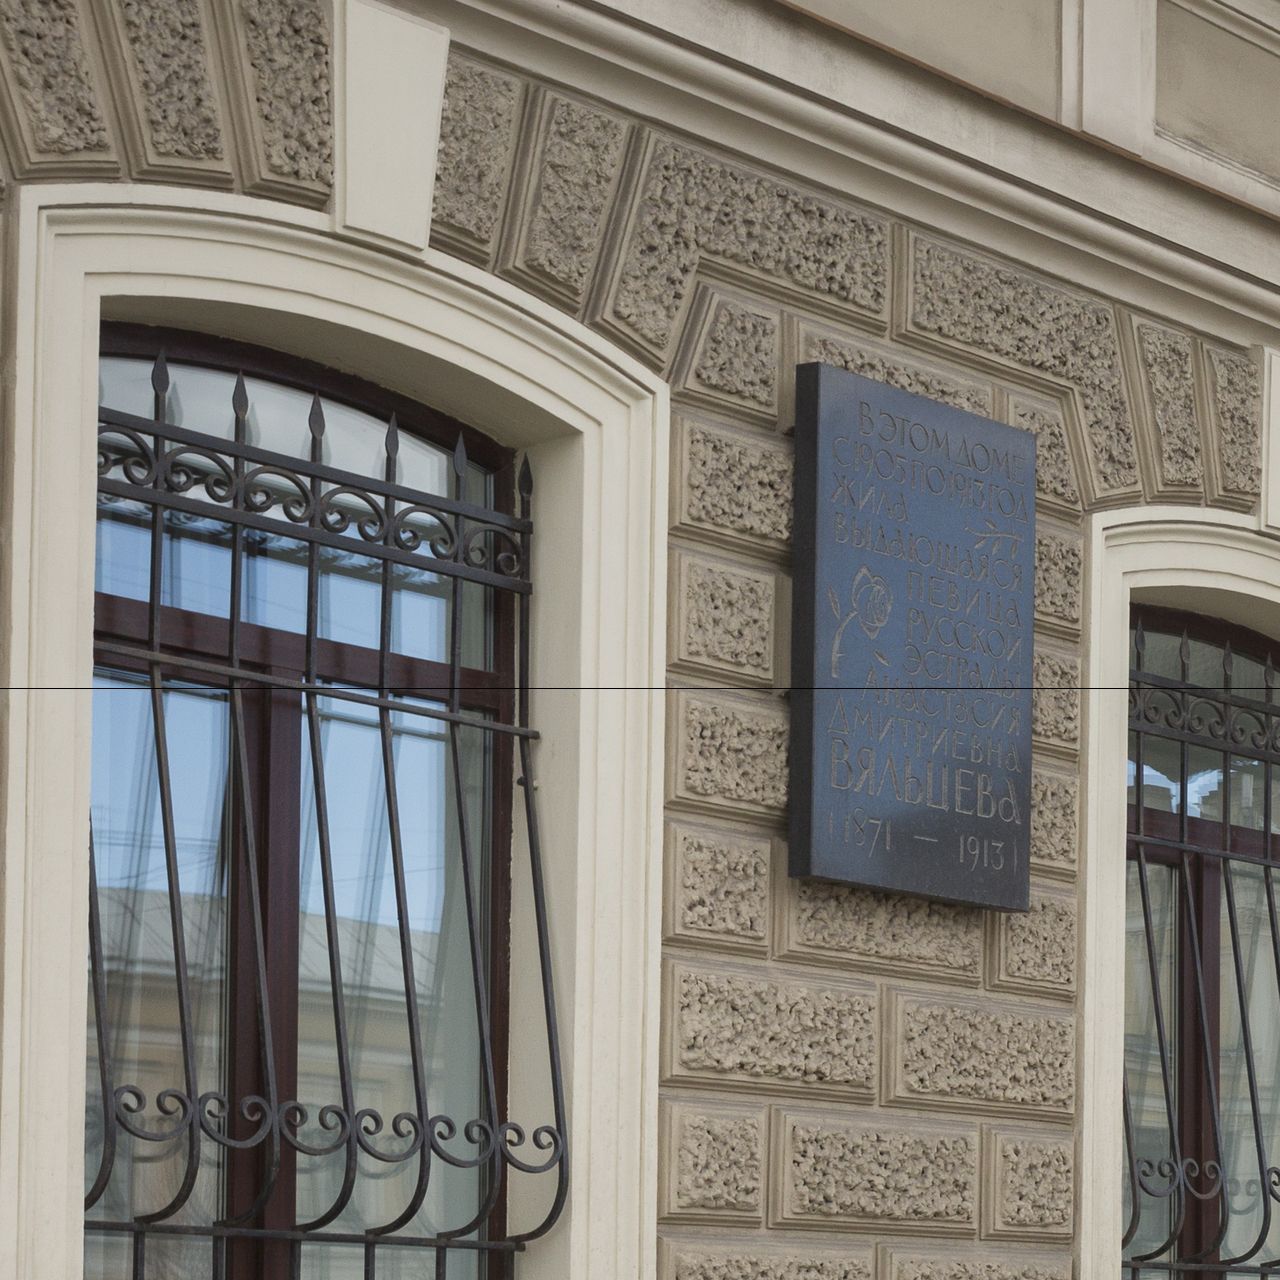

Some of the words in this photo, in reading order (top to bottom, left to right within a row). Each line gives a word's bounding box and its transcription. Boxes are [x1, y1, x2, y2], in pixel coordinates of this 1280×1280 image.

[832, 434, 852, 468] С
[854, 440, 909, 486] 1905
[911, 459, 946, 496] ПО
[948, 470, 986, 511] 1913
[988, 483, 1029, 525] ГОД
[858, 400, 875, 438] В
[877, 409, 951, 461] ЭТОМ
[956, 433, 1026, 487] ДОМЕ
[832, 510, 1024, 594] ВЫДАЮЩАЯСЯ
[906, 569, 1024, 629] ПЕВИЦА
[860, 665, 1022, 737] АНАСТАСИЯ
[902, 642, 1022, 702] ЭСТРАДЫ
[826, 694, 1023, 775] ДМИТРИЕВНА
[830, 737, 1023, 826] ВЯЛЬЦЕВА
